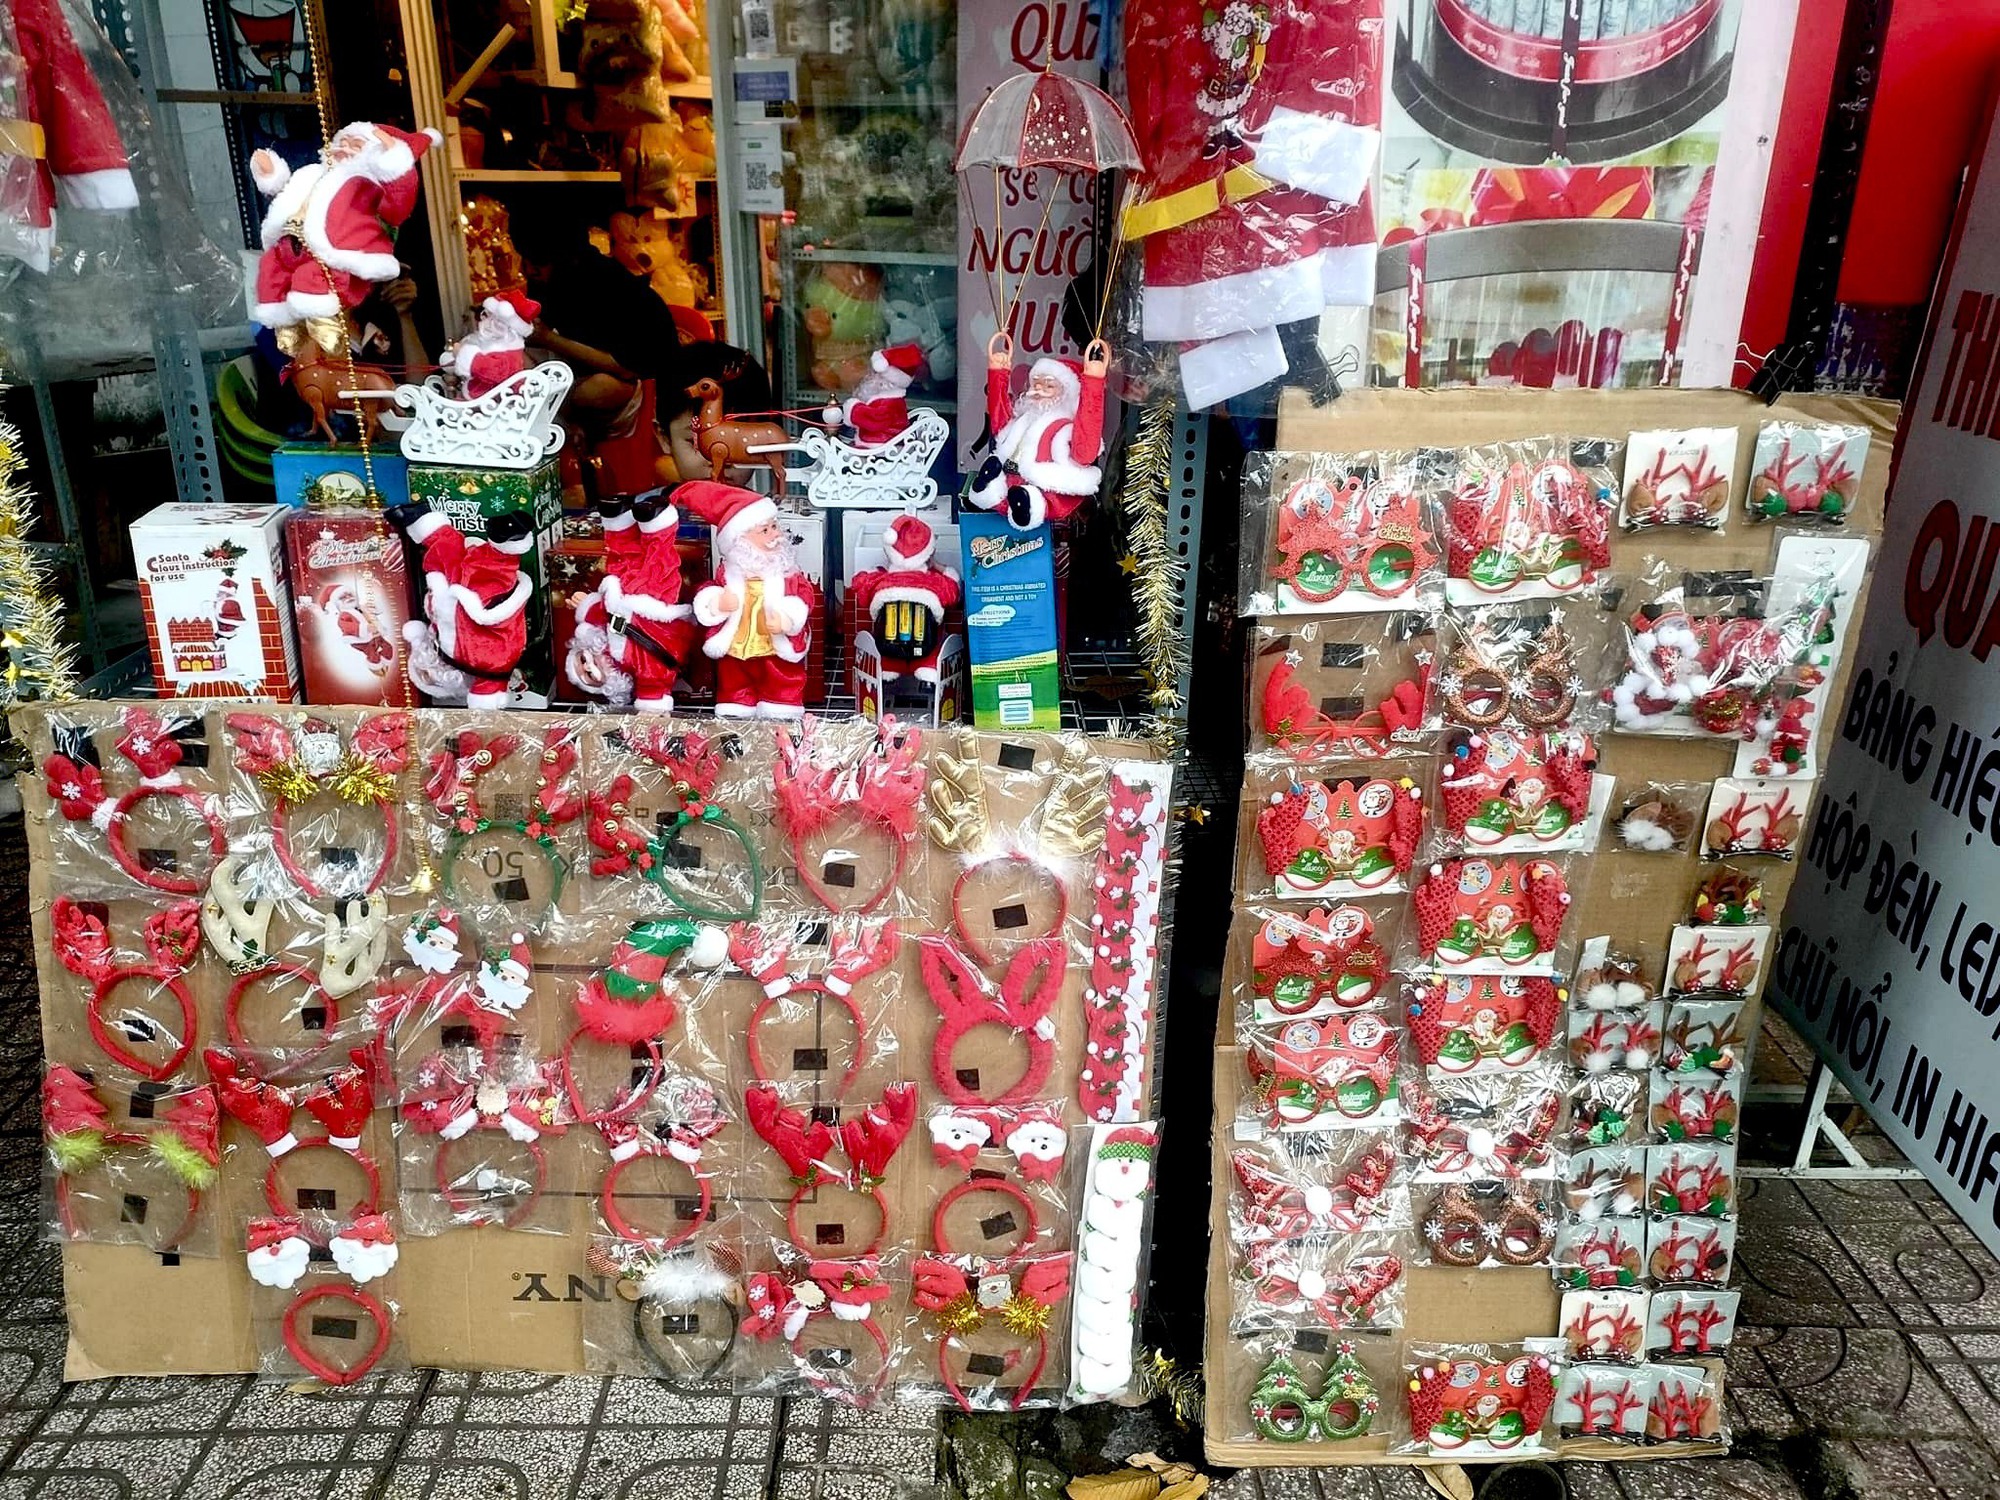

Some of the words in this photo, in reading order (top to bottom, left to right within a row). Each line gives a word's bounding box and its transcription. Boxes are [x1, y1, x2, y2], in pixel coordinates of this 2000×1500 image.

[967, 217, 1093, 277] NGƯỜ
[1931, 289, 2000, 441] THI
[427, 495, 481, 514] Merry
[158, 553, 190, 563] Santa
[182, 559, 235, 571] instruction
[981, 536, 1044, 569] Christmas
[150, 574, 164, 582] for
[1842, 650, 1937, 785] BẢNG
[1806, 790, 1871, 894] HỘP
[1826, 971, 1892, 1105] NỔI,
[1891, 1043, 1943, 1141] IN
